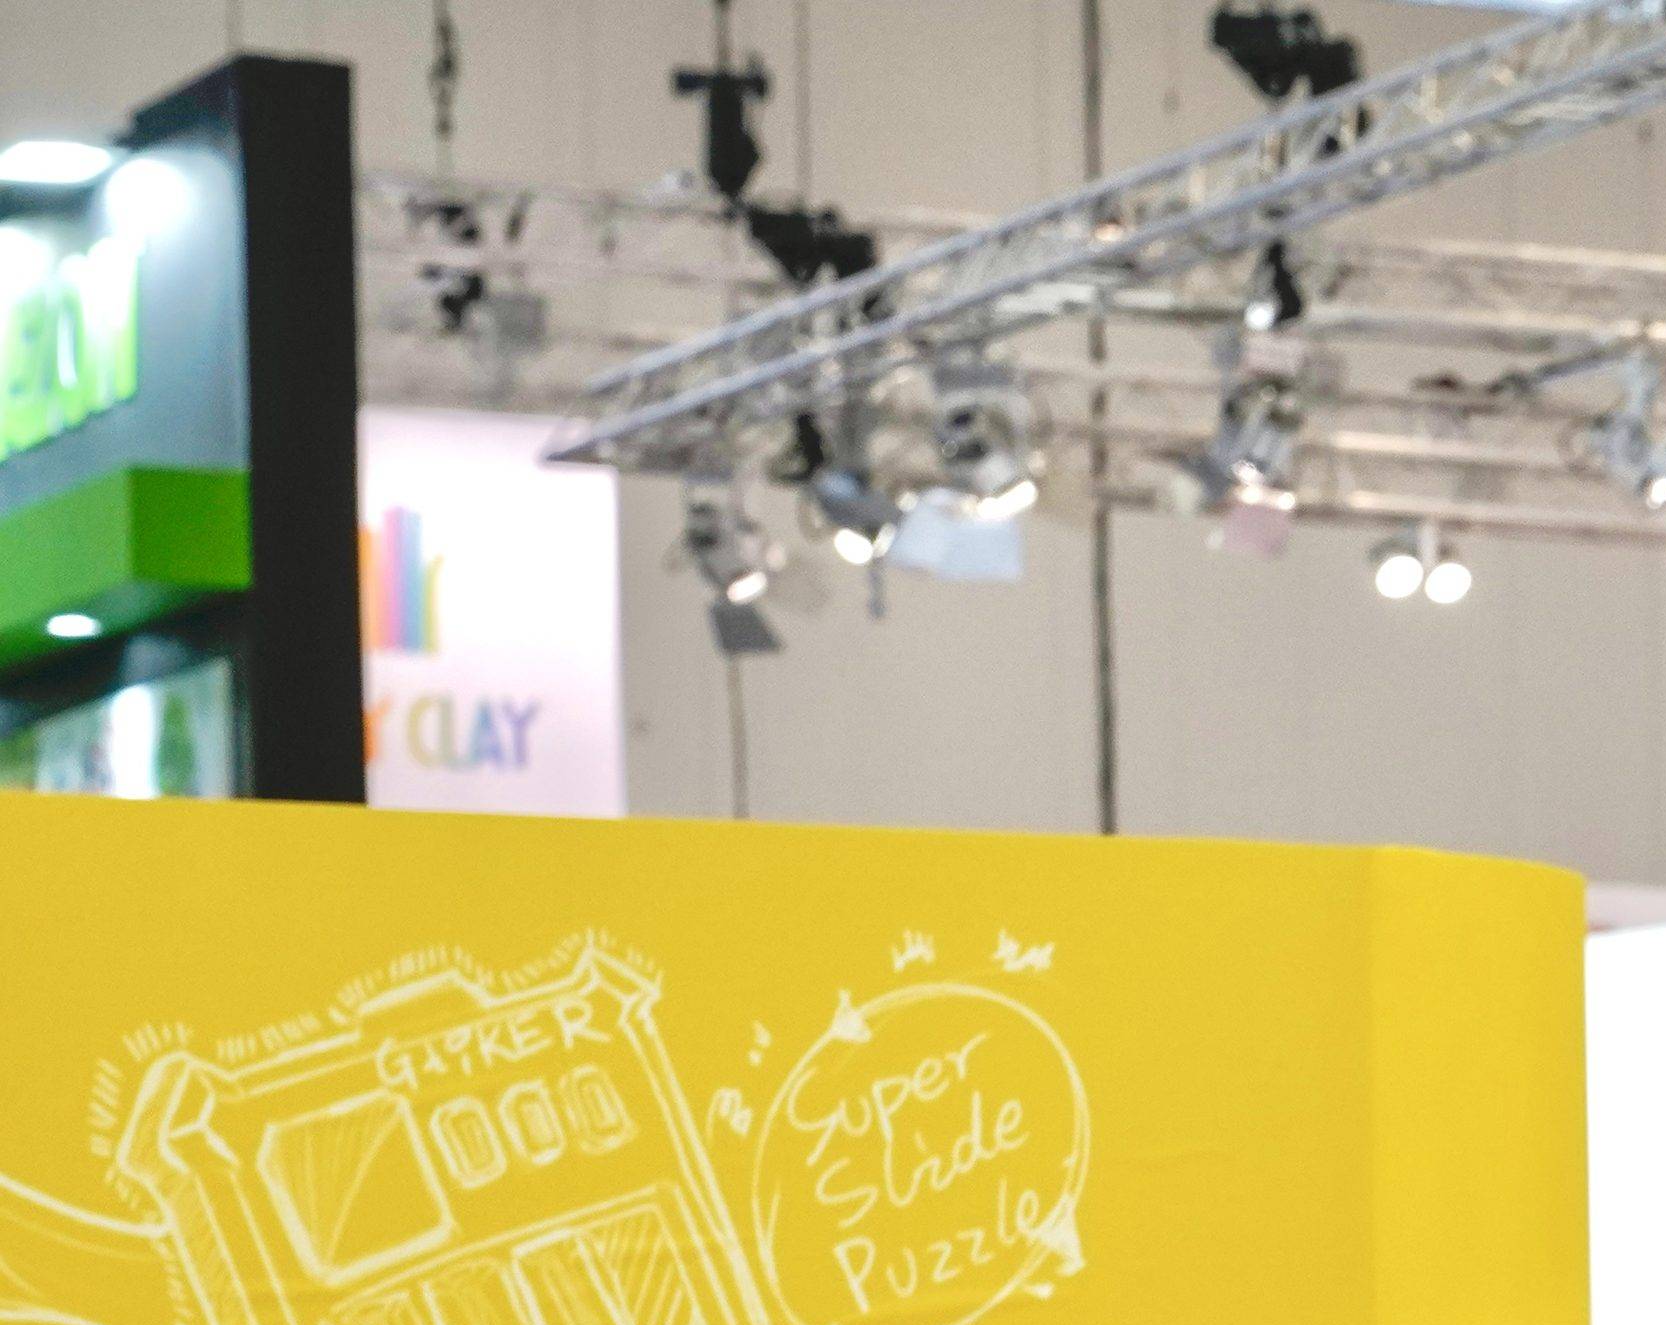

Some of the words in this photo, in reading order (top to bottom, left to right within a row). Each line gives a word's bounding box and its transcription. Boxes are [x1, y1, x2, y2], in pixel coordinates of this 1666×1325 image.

[406, 692, 543, 770] CLAY
[786, 1031, 992, 1168] Super
[814, 1090, 1030, 1229] Slide
[832, 1176, 1042, 1315] Puzzle
